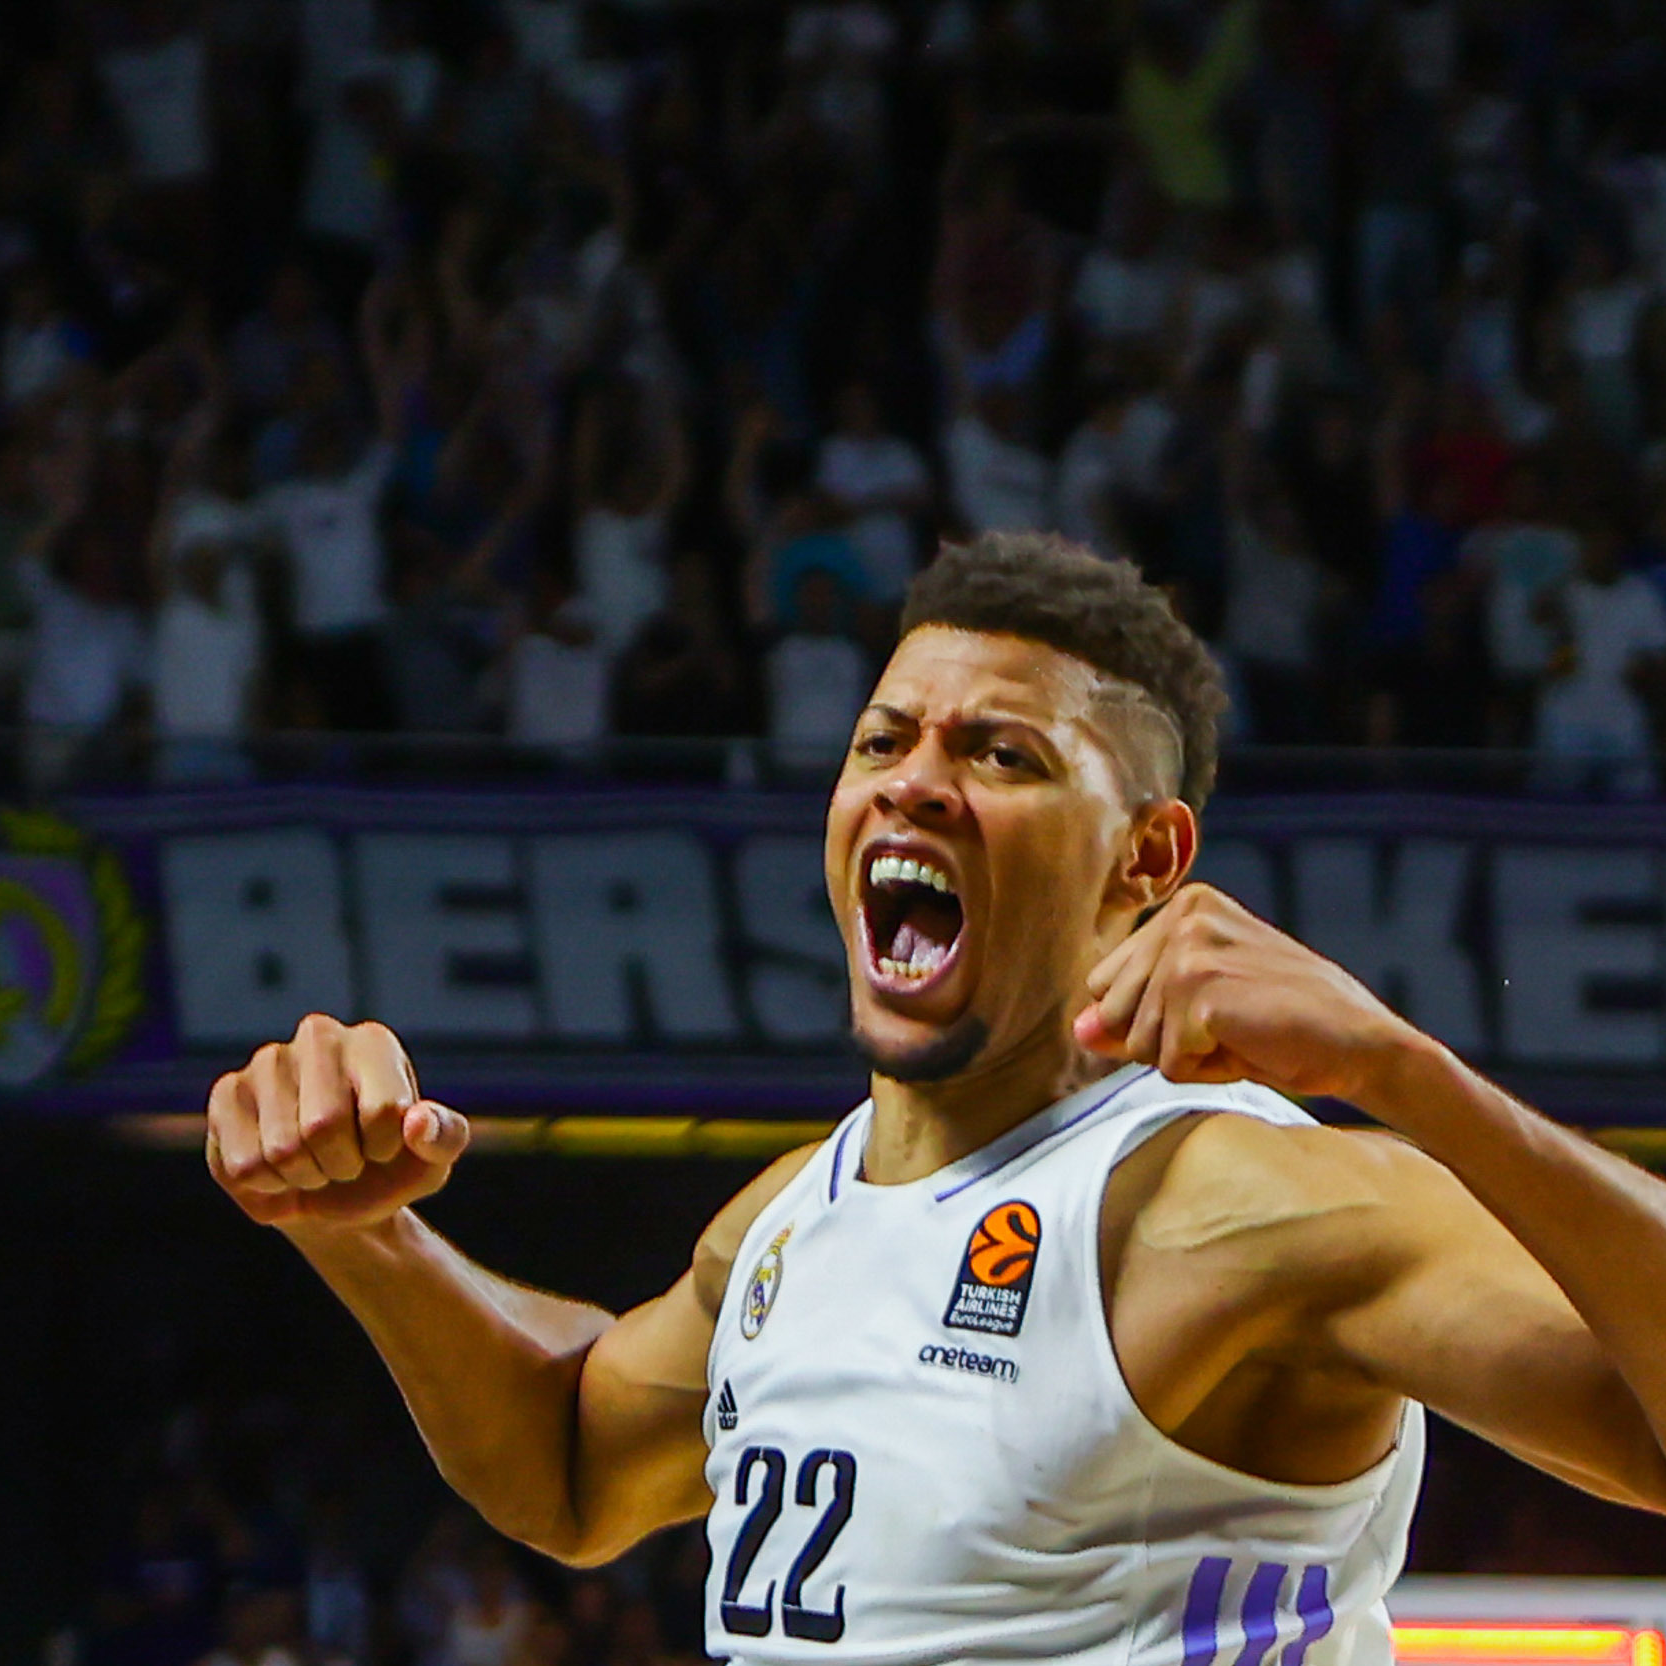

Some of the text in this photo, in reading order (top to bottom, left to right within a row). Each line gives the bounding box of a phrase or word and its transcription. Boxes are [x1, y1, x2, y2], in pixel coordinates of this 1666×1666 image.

[954, 1297, 1019, 1320] AIRLINES
[959, 1282, 1022, 1306] TURKISH
[918, 1344, 1019, 1382] oneteam
[719, 1446, 858, 1643] 22
